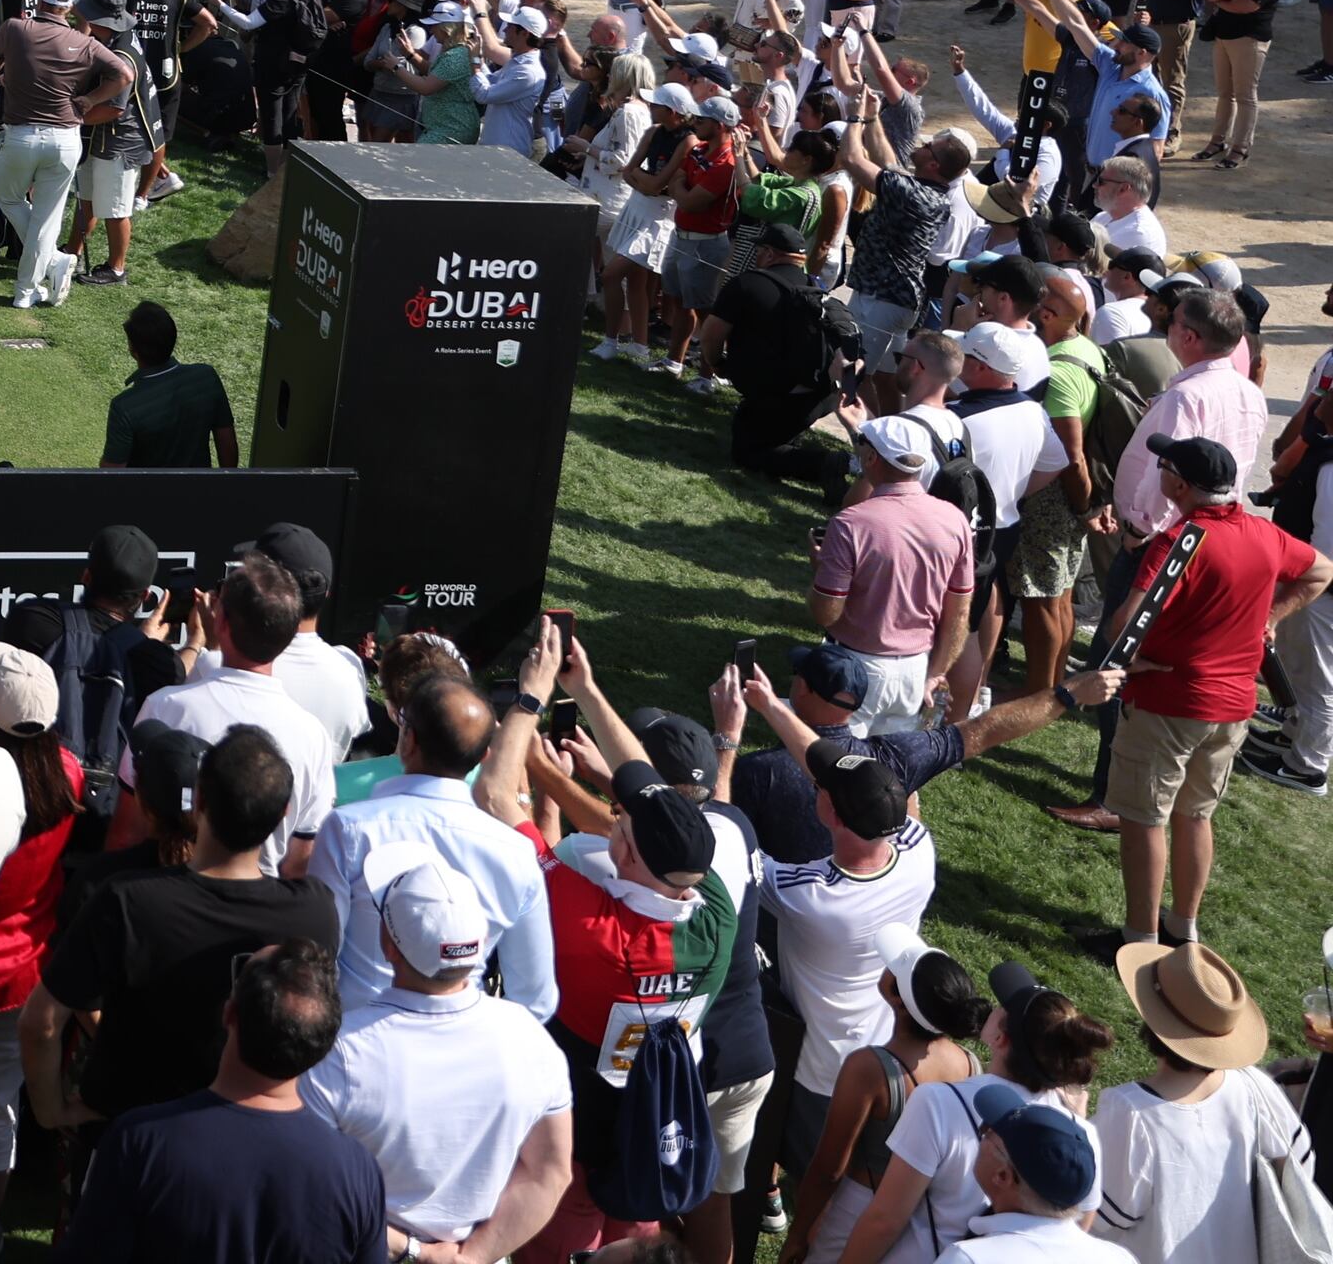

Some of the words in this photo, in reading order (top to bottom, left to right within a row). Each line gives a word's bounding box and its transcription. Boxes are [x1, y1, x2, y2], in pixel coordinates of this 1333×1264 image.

[146, 3, 169, 12] Hero
[134, 12, 168, 24] DUBAI
[133, 29, 167, 41] CILROY
[1019, 76, 1047, 168] QUIET
[314, 218, 343, 255] Hero
[296, 239, 342, 297] DUBAI
[468, 259, 538, 279] Hero
[428, 290, 540, 319] DUBAI
[426, 320, 475, 329] DESERT
[481, 321, 536, 330] CLASSIC
[424, 583, 439, 592] DP
[440, 583, 477, 592] WORLD
[1122, 533, 1196, 654] QUIET
[424, 591, 476, 608] TOUR
[444, 944, 477, 956] Titleist
[638, 973, 694, 996] UAE
